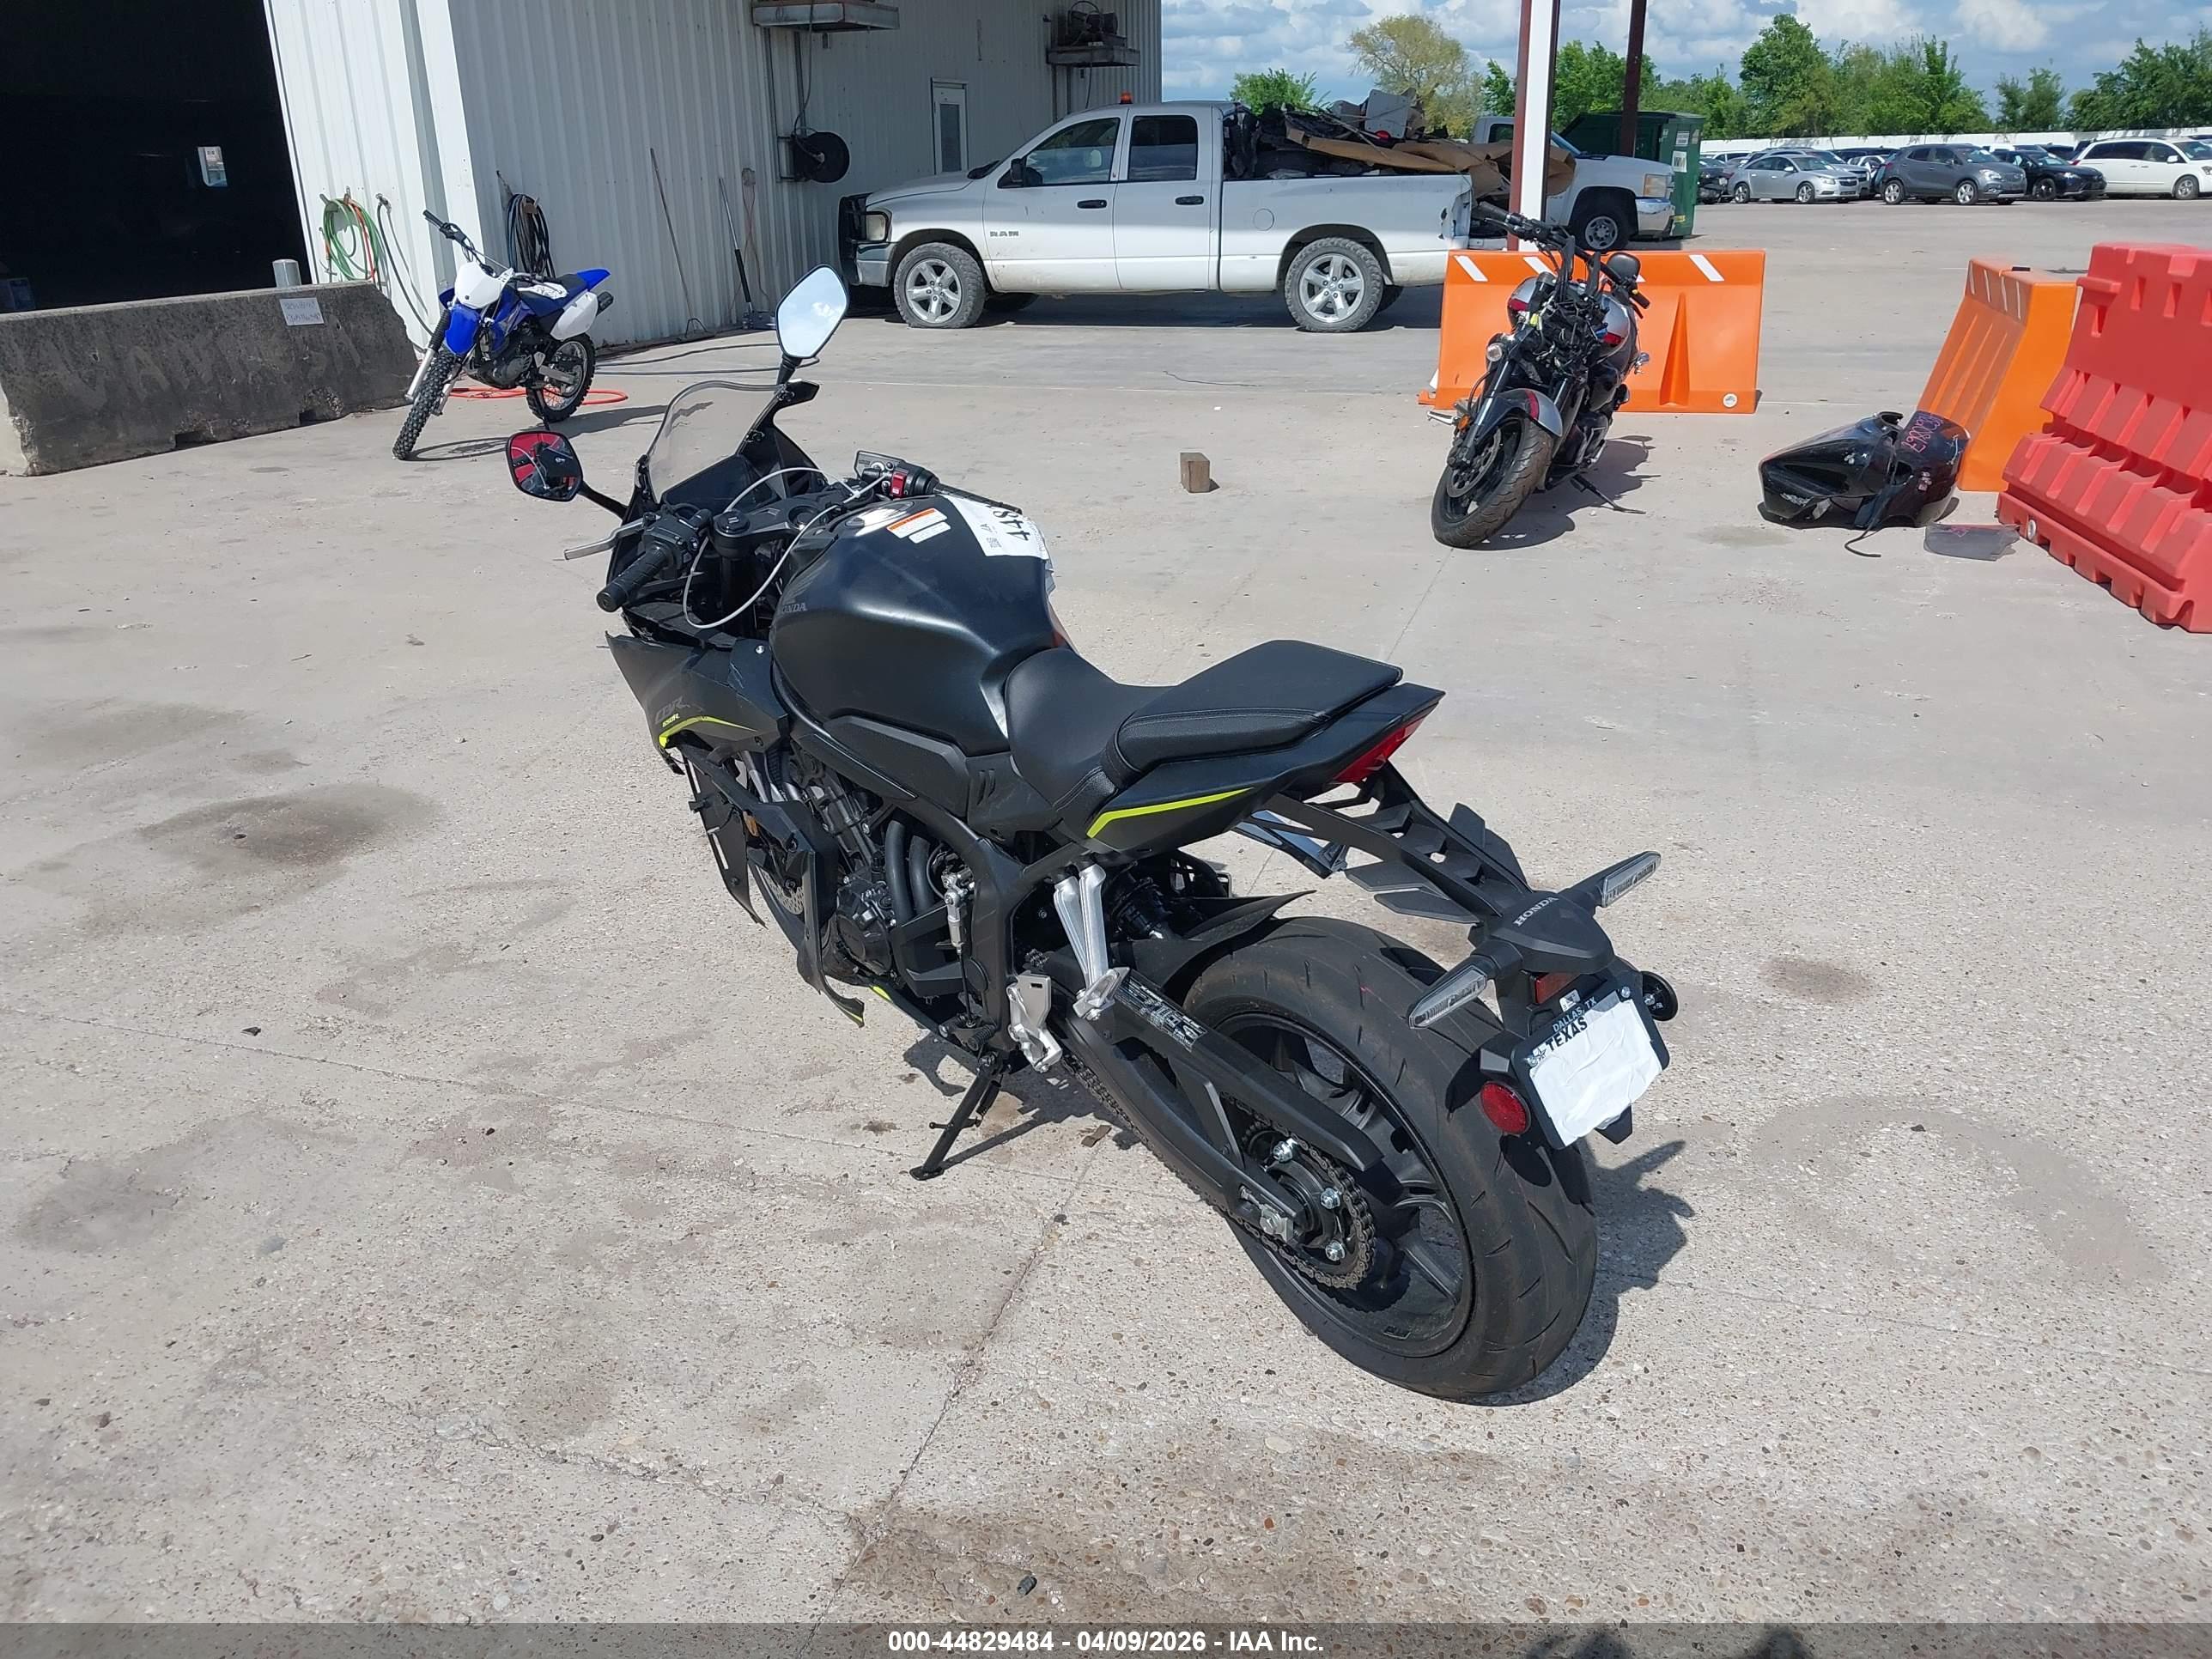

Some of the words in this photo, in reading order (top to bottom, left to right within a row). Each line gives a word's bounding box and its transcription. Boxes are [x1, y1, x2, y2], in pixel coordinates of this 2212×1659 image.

[1513, 896, 1559, 927] HONDA
[1584, 996, 1598, 1009] TX
[1545, 1016, 1588, 1051] TEXAS
